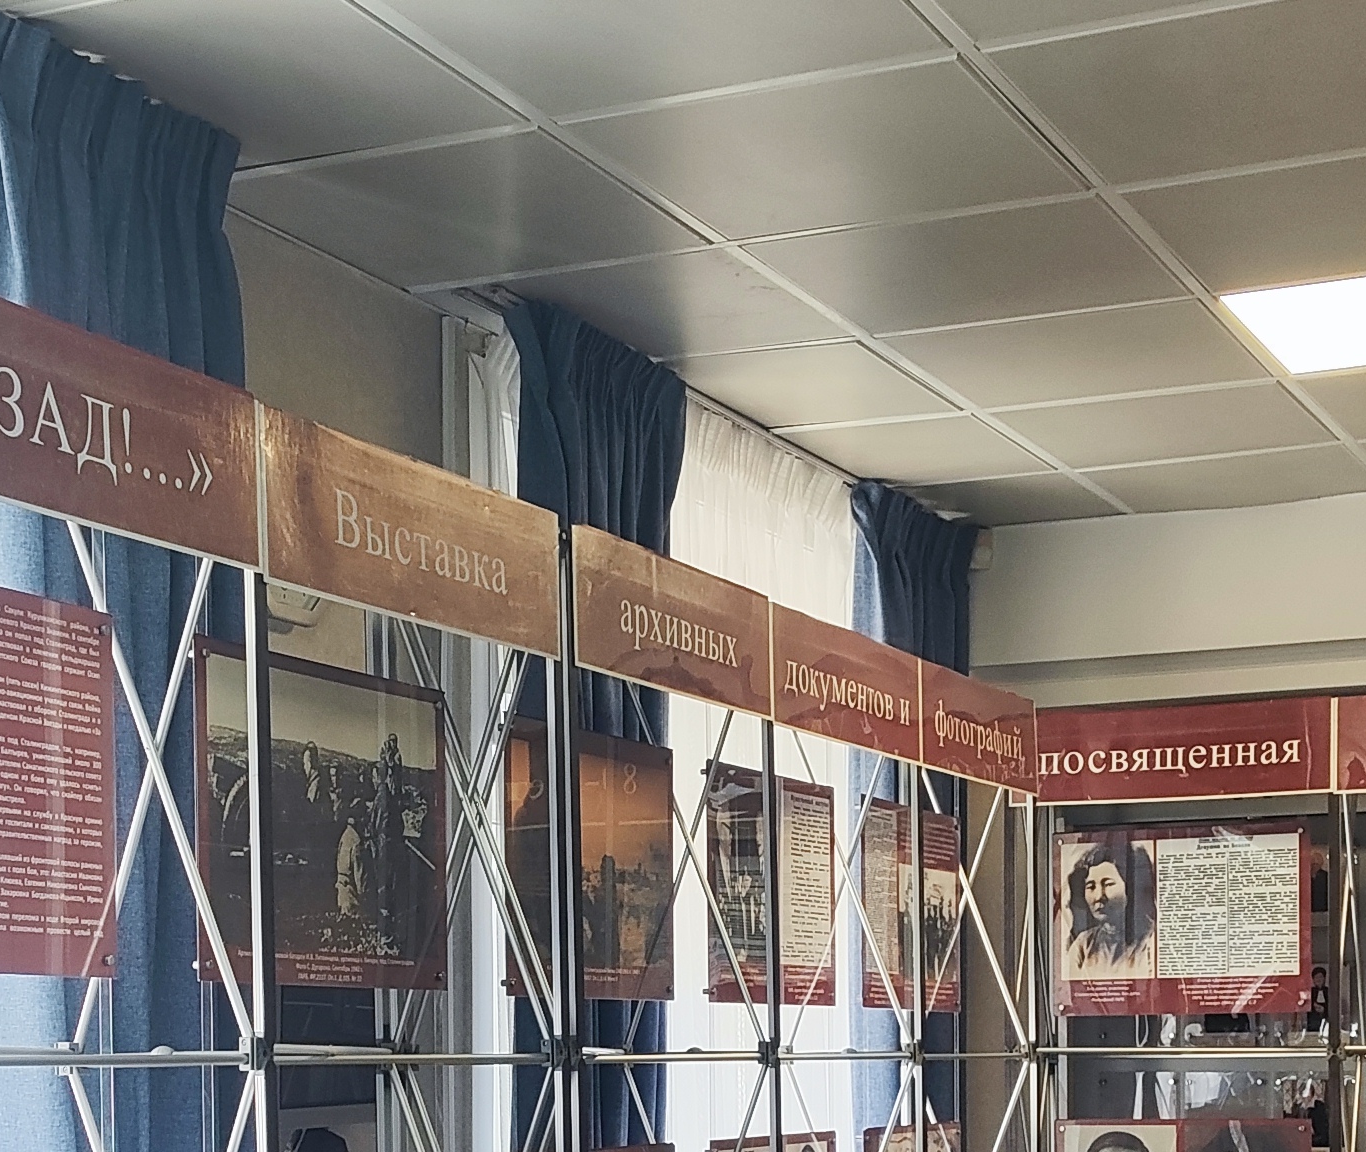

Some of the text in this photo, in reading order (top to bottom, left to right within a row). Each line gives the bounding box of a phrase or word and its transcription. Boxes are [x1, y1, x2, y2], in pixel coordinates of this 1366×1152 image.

[335, 489, 508, 597] Выставка
[620, 598, 739, 668] архивных
[784, 659, 895, 721] документов
[900, 696, 911, 727] и
[1038, 736, 1301, 778] посвященная
